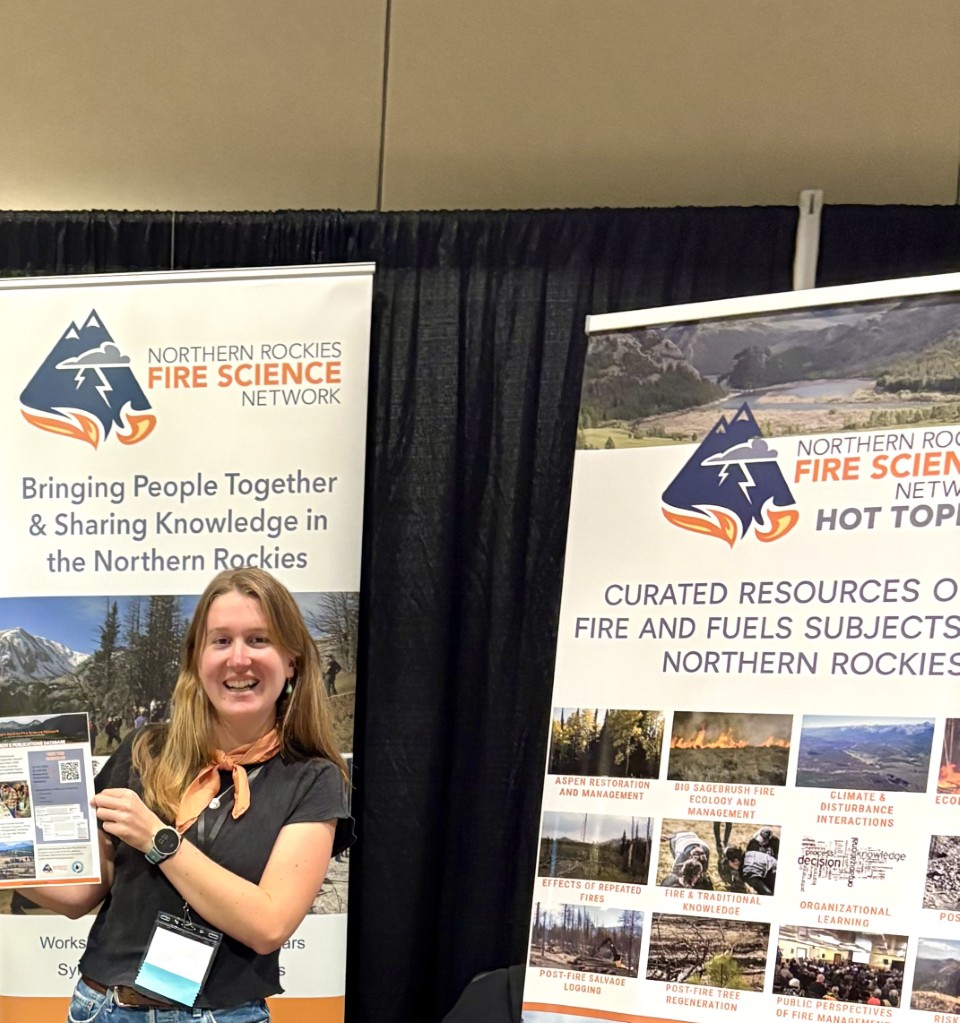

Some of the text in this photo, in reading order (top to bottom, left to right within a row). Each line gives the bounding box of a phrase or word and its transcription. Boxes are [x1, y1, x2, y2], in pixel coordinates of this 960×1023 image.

[148, 341, 342, 363] NORTHERN ROCKIES
[148, 361, 342, 389] FIRE SCIENCE
[242, 388, 341, 406] NETWORK
[797, 432, 915, 456] NORTHERN
[794, 451, 960, 484] FIRE SCIEN
[22, 470, 338, 505] Bringing People Together
[29, 508, 328, 541] & Sharing Knowledge in
[815, 507, 882, 531] HOT
[47, 545, 308, 573] the Northern Rockies
[604, 582, 728, 606] CURATED
[739, 578, 920, 605] RESOURCES
[574, 615, 960, 640] FIRE AND FUELS SUBJECTS
[662, 650, 960, 676] NORTHERN ROCKIES
[555, 776, 650, 789] ASPEN RESTORATION
[674, 783, 775, 796] BIG SAGEBRUSH FIRE
[559, 788, 644, 800] AND MANAGEMENT
[689, 795, 756, 807] ECOLOGY AND
[830, 791, 886, 802] CLIMATE &
[688, 807, 756, 819] MANAGEMENT
[820, 802, 894, 814] DISTURBANCE
[816, 815, 894, 827] INTERACTIONS
[797, 855, 841, 868] decision
[856, 850, 906, 862] knowledge
[542, 879, 642, 895] EFFECTS OF REPEATED
[580, 893, 605, 903] FIRES
[665, 888, 762, 906] FIRE & TRADITIONAL
[683, 903, 740, 916] KNOWLEDGE
[800, 901, 892, 916] ORGANIZATIONAL
[818, 915, 869, 928] LEARNING
[539, 969, 626, 987] POST-FIRE SALVAGE
[563, 983, 602, 995] LOGGING
[665, 983, 741, 1000] POST-FIRE TREE
[665, 995, 738, 1012] REGENERATION
[777, 997, 893, 1018] PUBLIC PERSPECTIVES
[776, 1008, 789, 1018] OF
[792, 1010, 814, 1021] FIRE
